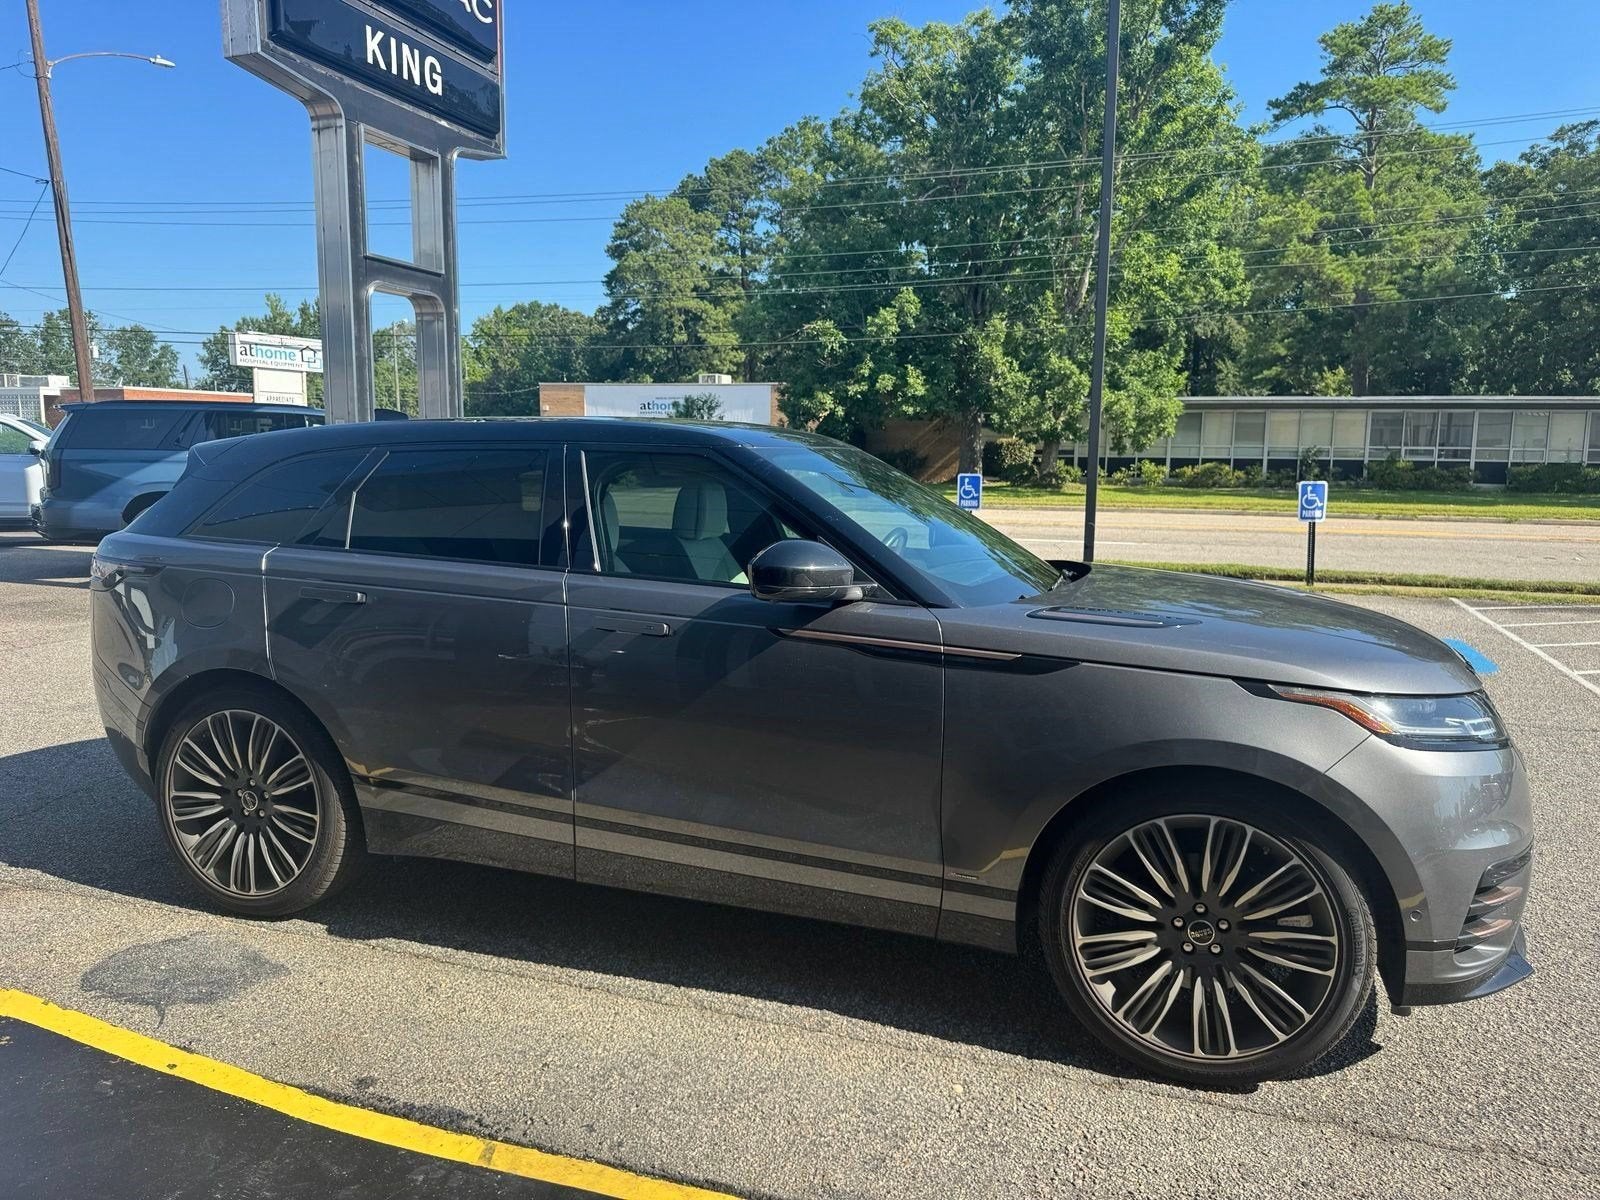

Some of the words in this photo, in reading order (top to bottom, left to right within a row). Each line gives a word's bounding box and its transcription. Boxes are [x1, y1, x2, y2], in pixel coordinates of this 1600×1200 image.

[365, 24, 443, 96] KING
[240, 344, 296, 361] athome
[961, 499, 978, 507] PARKING
[1302, 510, 1322, 518] PARKING
